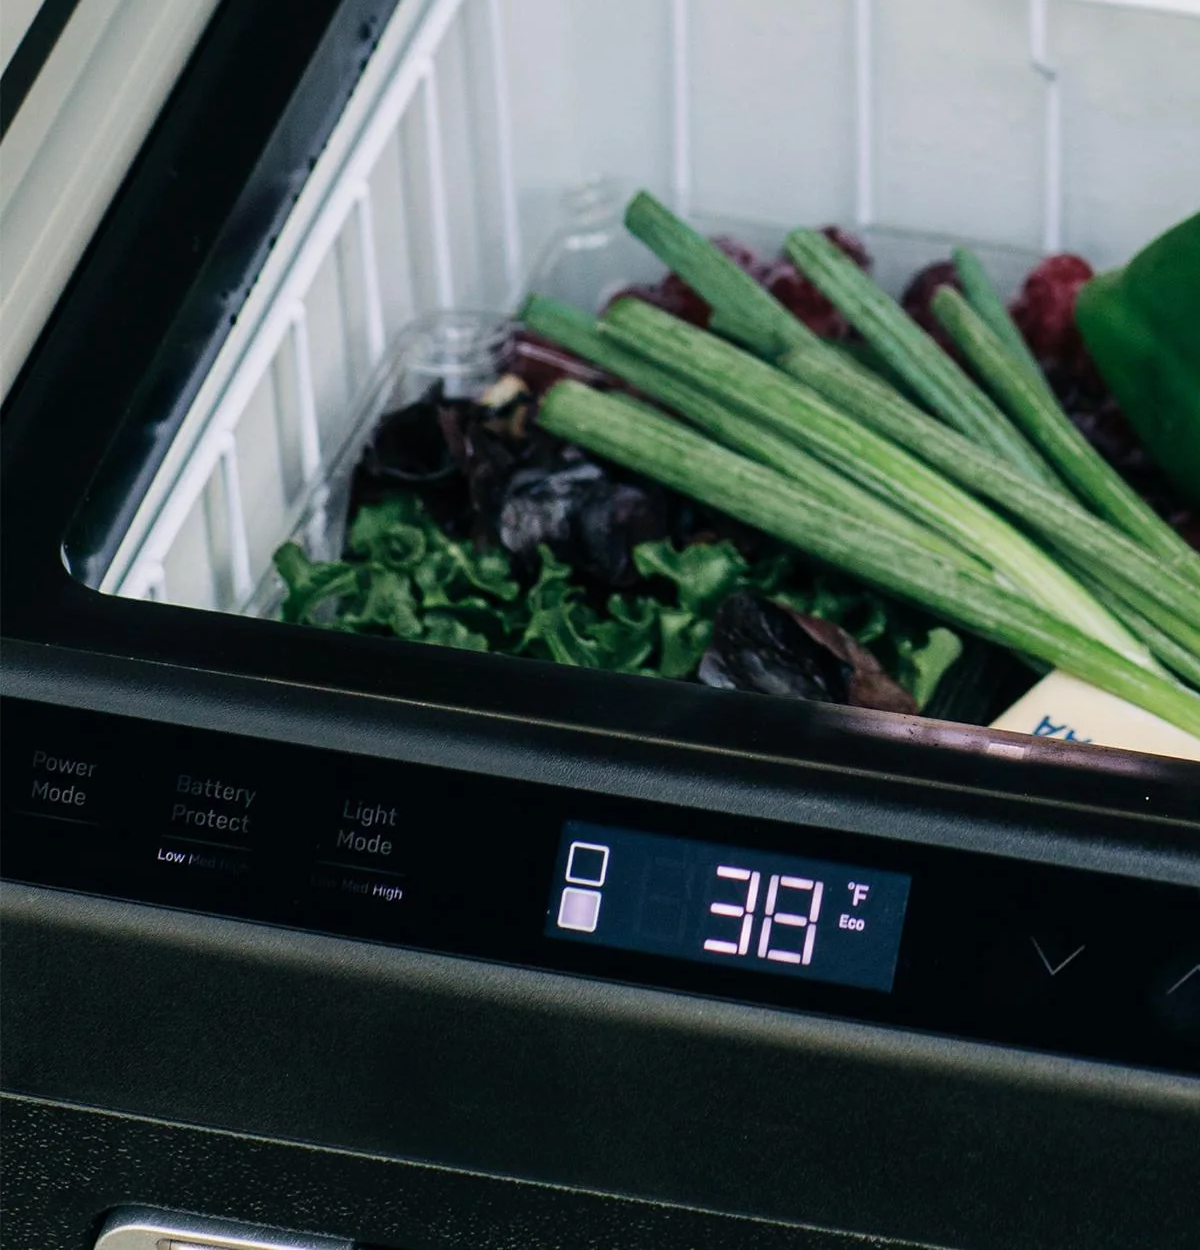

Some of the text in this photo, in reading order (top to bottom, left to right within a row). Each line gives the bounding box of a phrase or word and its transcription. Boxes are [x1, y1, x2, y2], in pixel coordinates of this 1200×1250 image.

[32, 751, 96, 778] Power
[31, 780, 86, 806] Mode
[176, 774, 256, 807] Battery
[171, 804, 250, 833] Protect
[343, 799, 397, 827] Light
[337, 829, 392, 855] Mode
[157, 848, 185, 864] Low
[372, 884, 402, 901] High
[703, 865, 824, 966] 38
[839, 914, 865, 931] Eco
